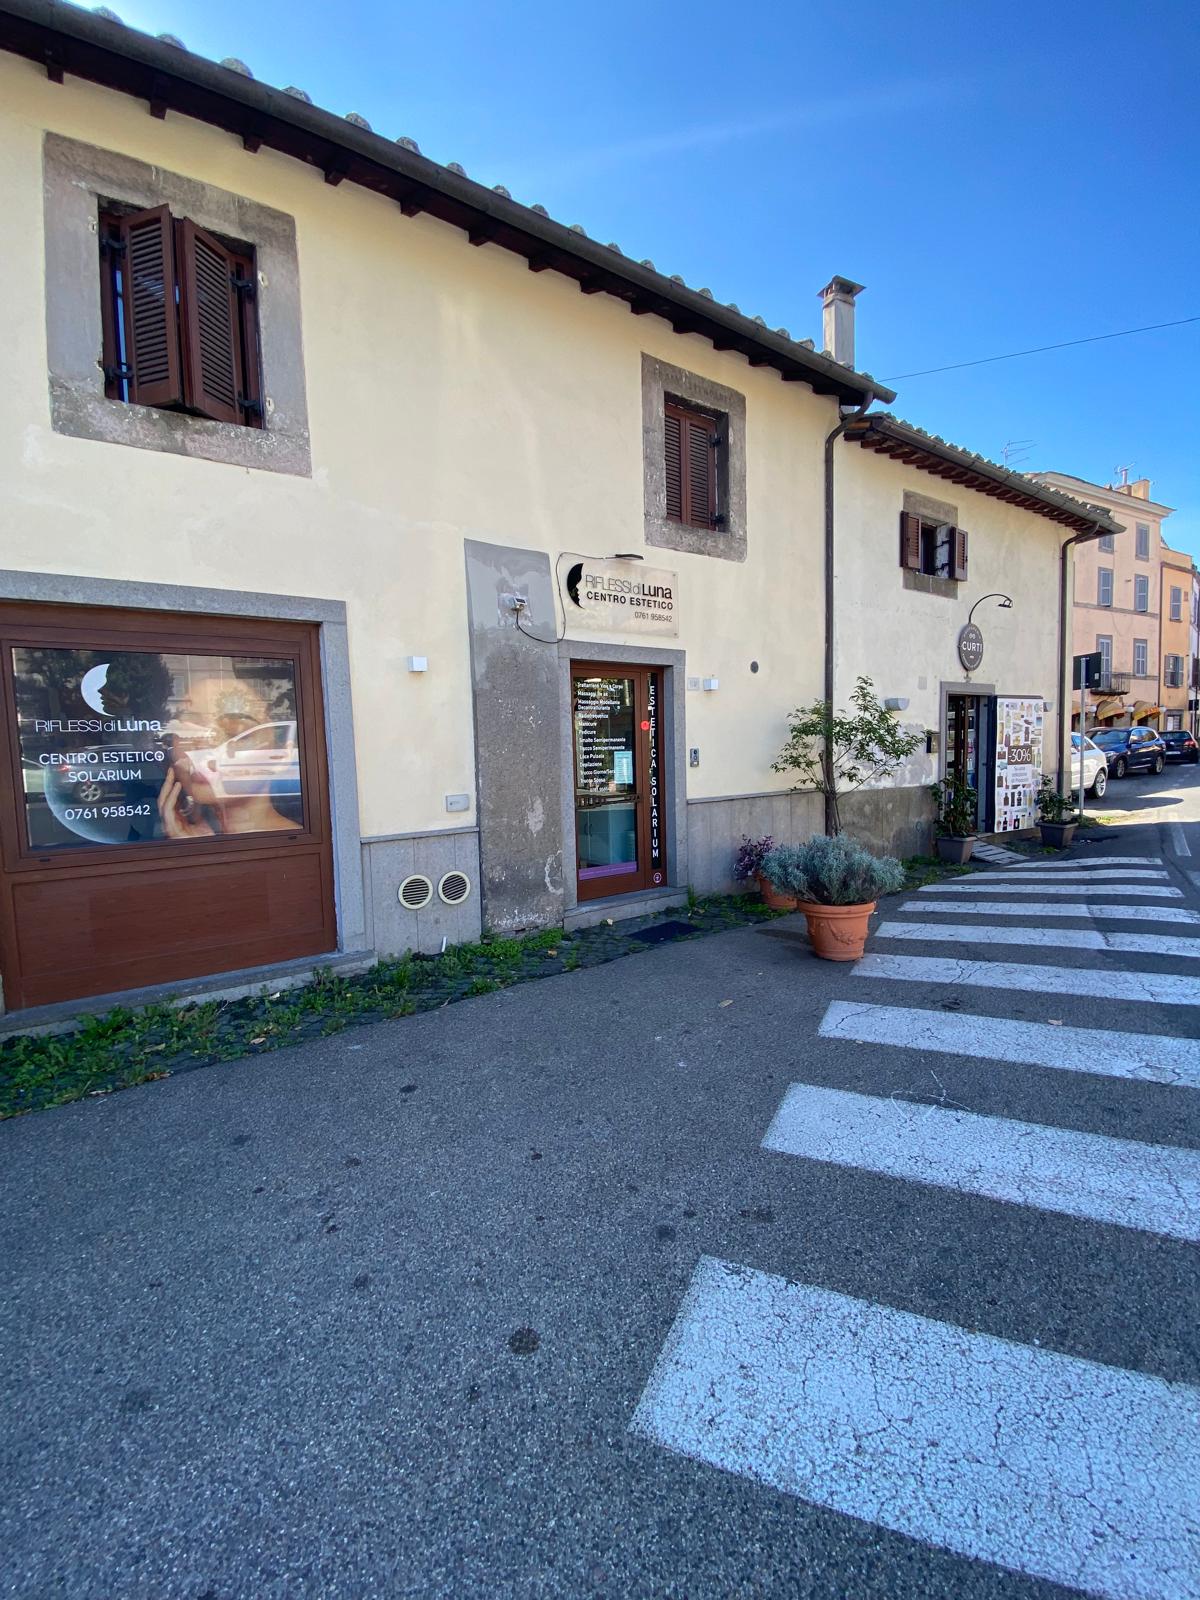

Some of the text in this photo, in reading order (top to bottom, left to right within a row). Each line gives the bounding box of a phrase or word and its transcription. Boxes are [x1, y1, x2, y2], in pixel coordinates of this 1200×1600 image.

[585, 574, 632, 594] RIFLESSI
[642, 583, 673, 600] Luna
[586, 591, 674, 611] CENTRO ESTETICO
[634, 611, 673, 623] 0761 958542
[962, 641, 983, 653] CURTI
[35, 718, 162, 733] RIFLESSI di Luna
[39, 750, 165, 766] CENTRO ESTETICO
[1008, 748, 1032, 762] -30%
[67, 769, 142, 784] SOLARIUM
[648, 685, 660, 858] ESTETICA SOLARIUM
[64, 803, 151, 820] 0761 958542
